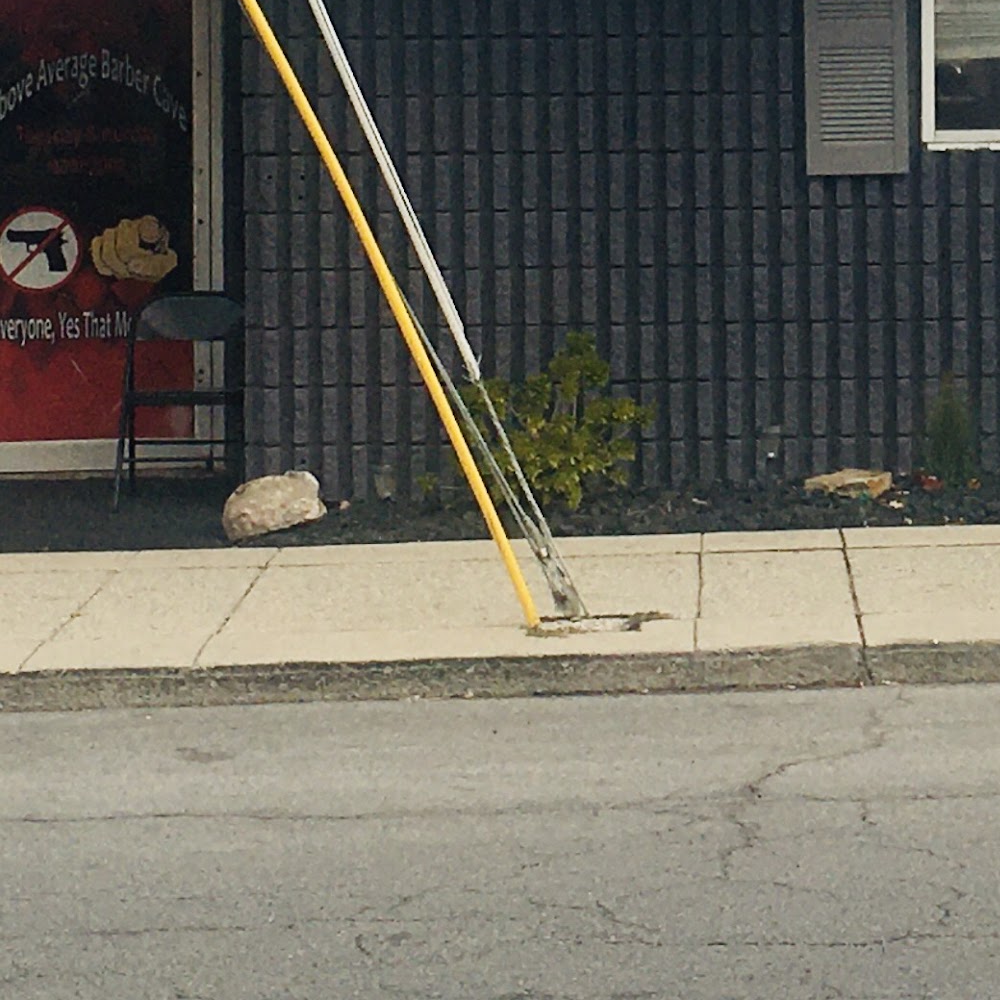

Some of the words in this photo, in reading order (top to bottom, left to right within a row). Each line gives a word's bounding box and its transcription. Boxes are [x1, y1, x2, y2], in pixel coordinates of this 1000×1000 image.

[0, 72, 33, 120] bove
[36, 53, 97, 91] Average
[101, 48, 149, 94] Barber
[152, 75, 188, 132] Cave
[0, 317, 56, 346] veryone,
[58, 312, 80, 339] Yes
[82, 311, 112, 338] That
